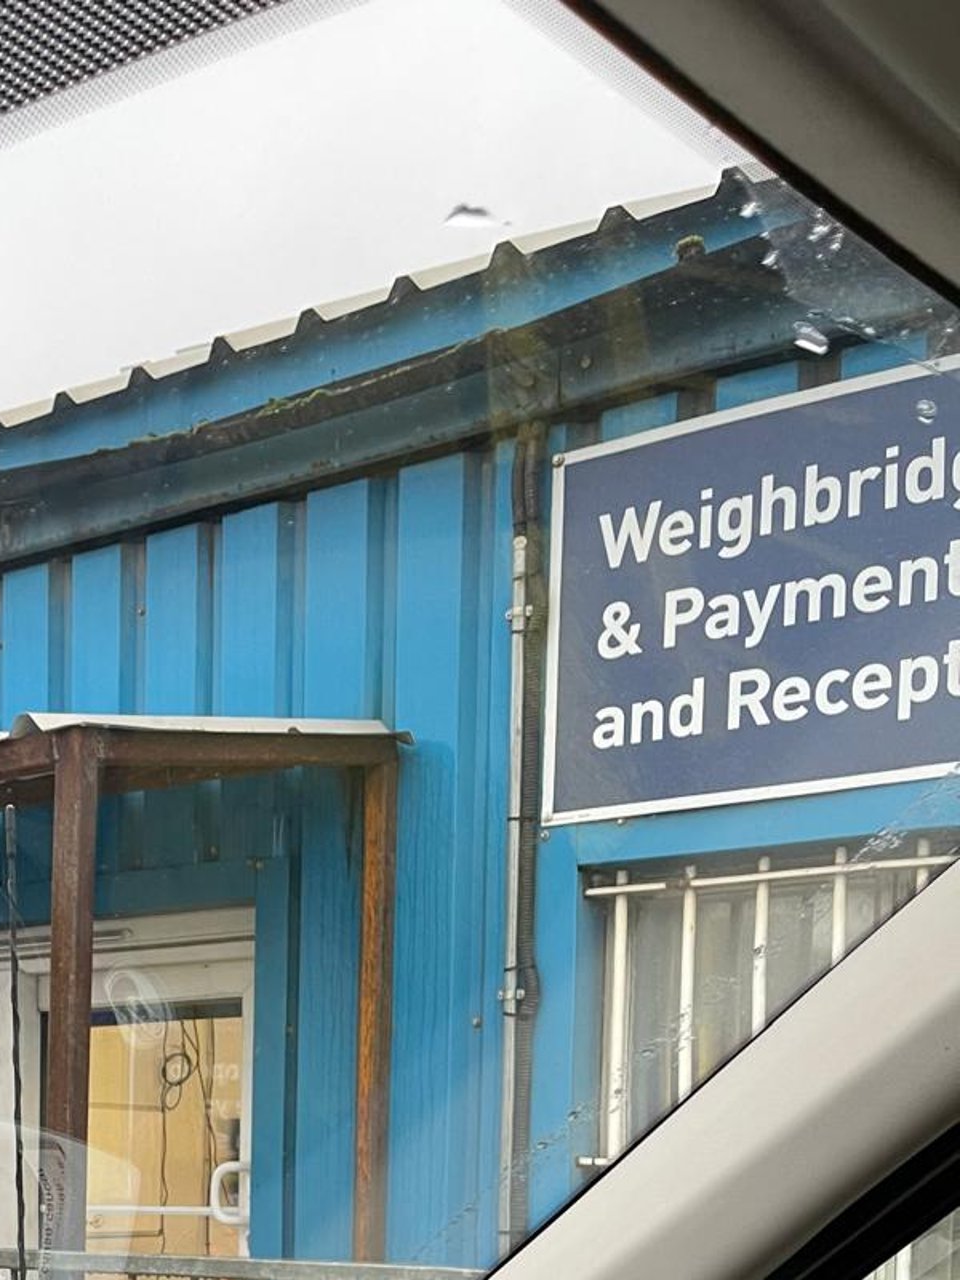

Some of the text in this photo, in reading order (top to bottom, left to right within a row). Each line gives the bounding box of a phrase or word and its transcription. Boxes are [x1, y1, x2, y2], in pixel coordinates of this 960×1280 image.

[599, 436, 960, 569] Weighbrid
[597, 600, 642, 660] &
[592, 676, 705, 750] and
